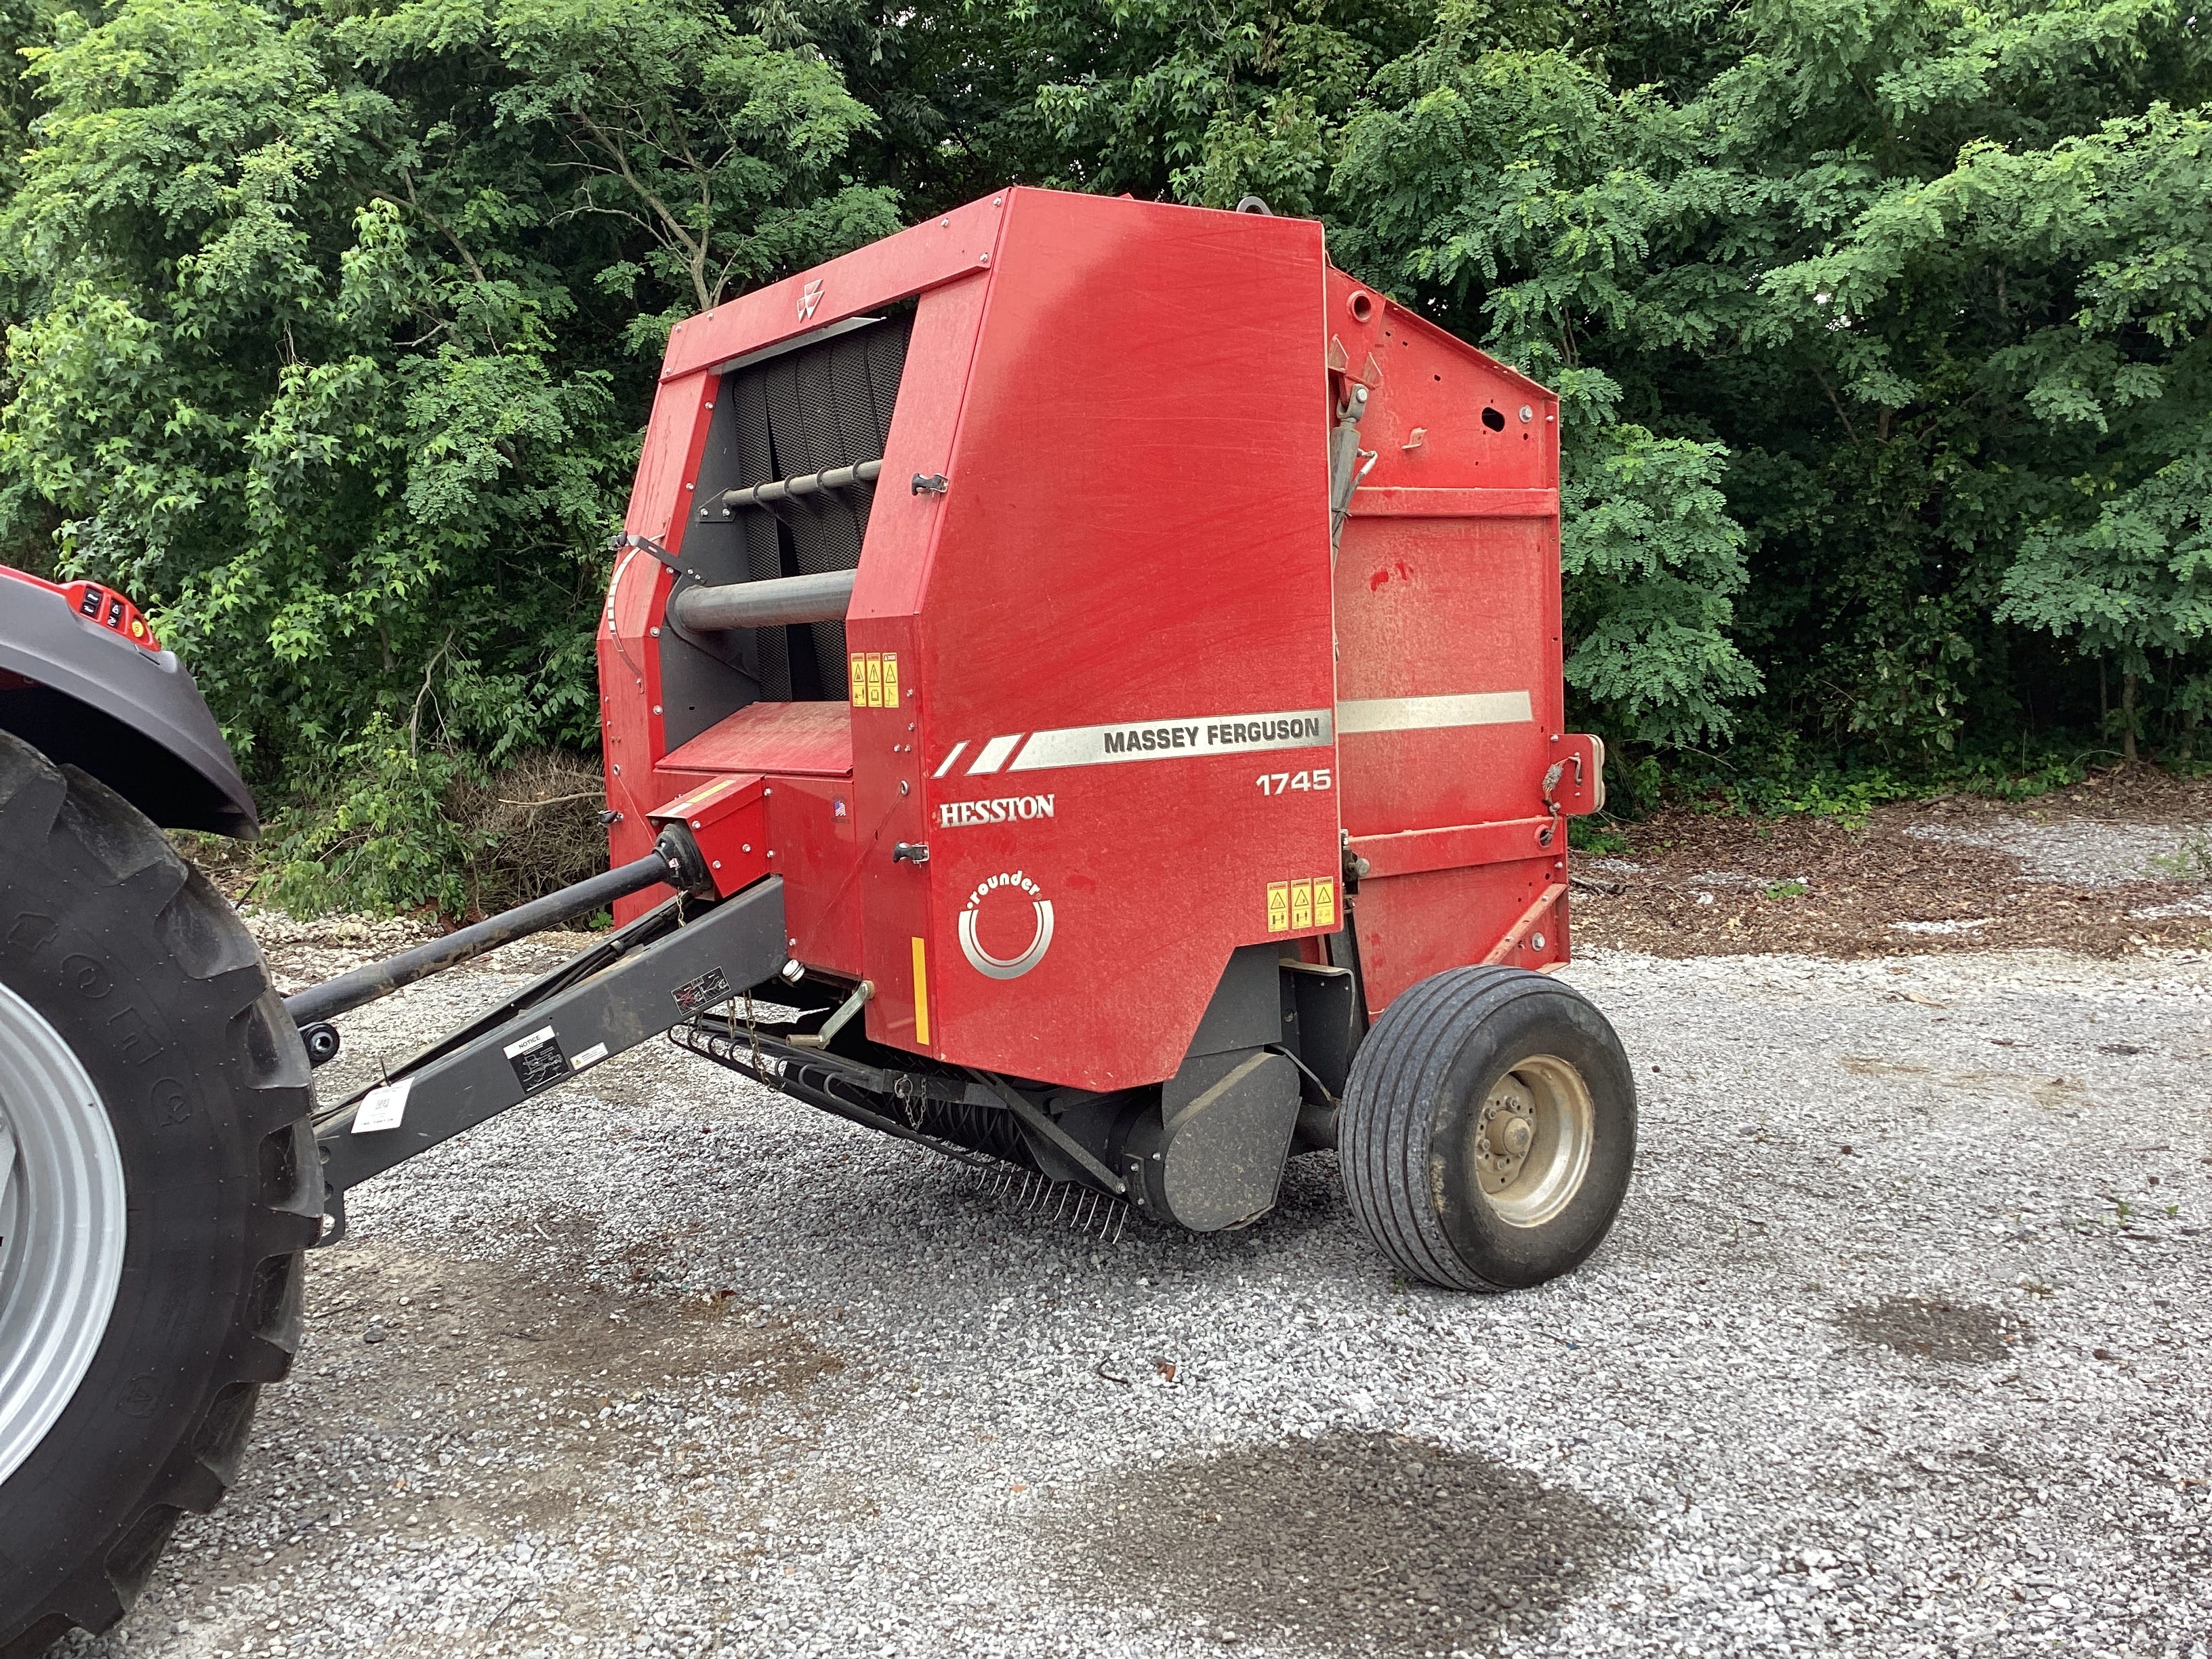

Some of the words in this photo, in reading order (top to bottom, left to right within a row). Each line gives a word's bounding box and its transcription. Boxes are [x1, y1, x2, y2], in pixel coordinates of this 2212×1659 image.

[1104, 726, 1199, 754] MASSEY
[1207, 718, 1319, 745] FERGUSON
[1256, 769, 1332, 796] 1745
[939, 794, 1055, 829] HESSTON
[518, 1035, 541, 1049] NOTICE
